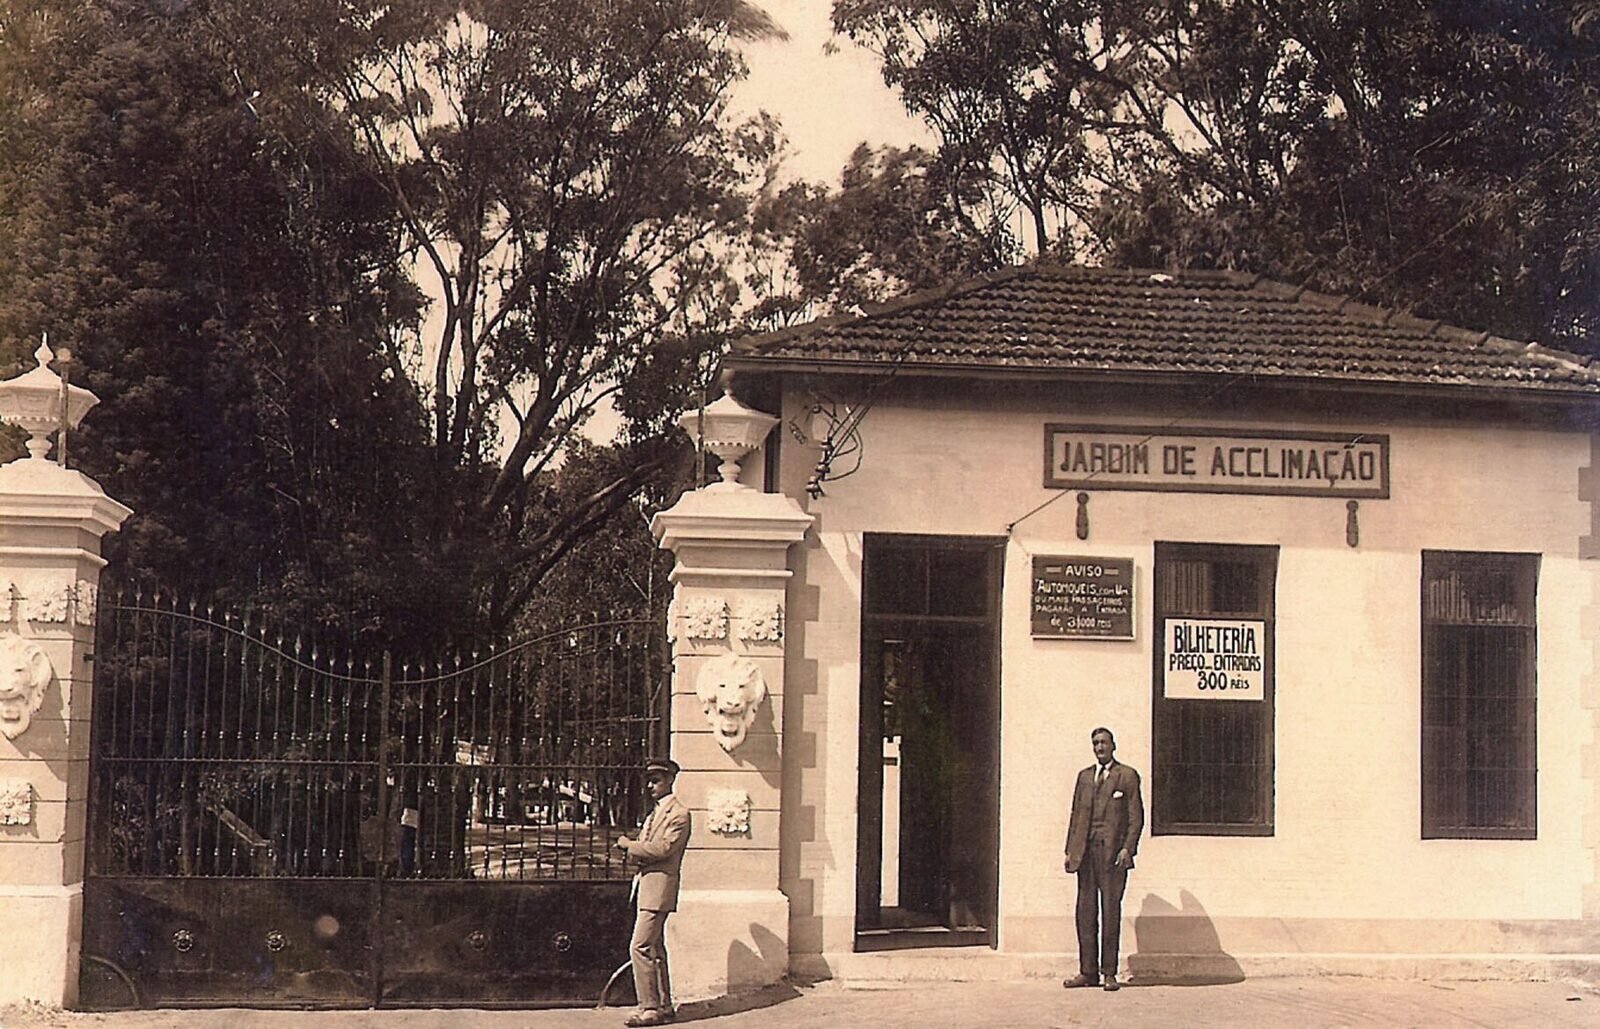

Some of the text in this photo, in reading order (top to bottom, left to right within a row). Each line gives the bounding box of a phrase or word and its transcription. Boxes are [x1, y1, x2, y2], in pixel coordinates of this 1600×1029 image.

[1060, 442, 1374, 487] JARDIM DE ACCLIMAÇÃO
[1065, 565, 1103, 577] AVISO
[1214, 654, 1261, 671] ENTRADAS
[1198, 671, 1228, 690] 300
